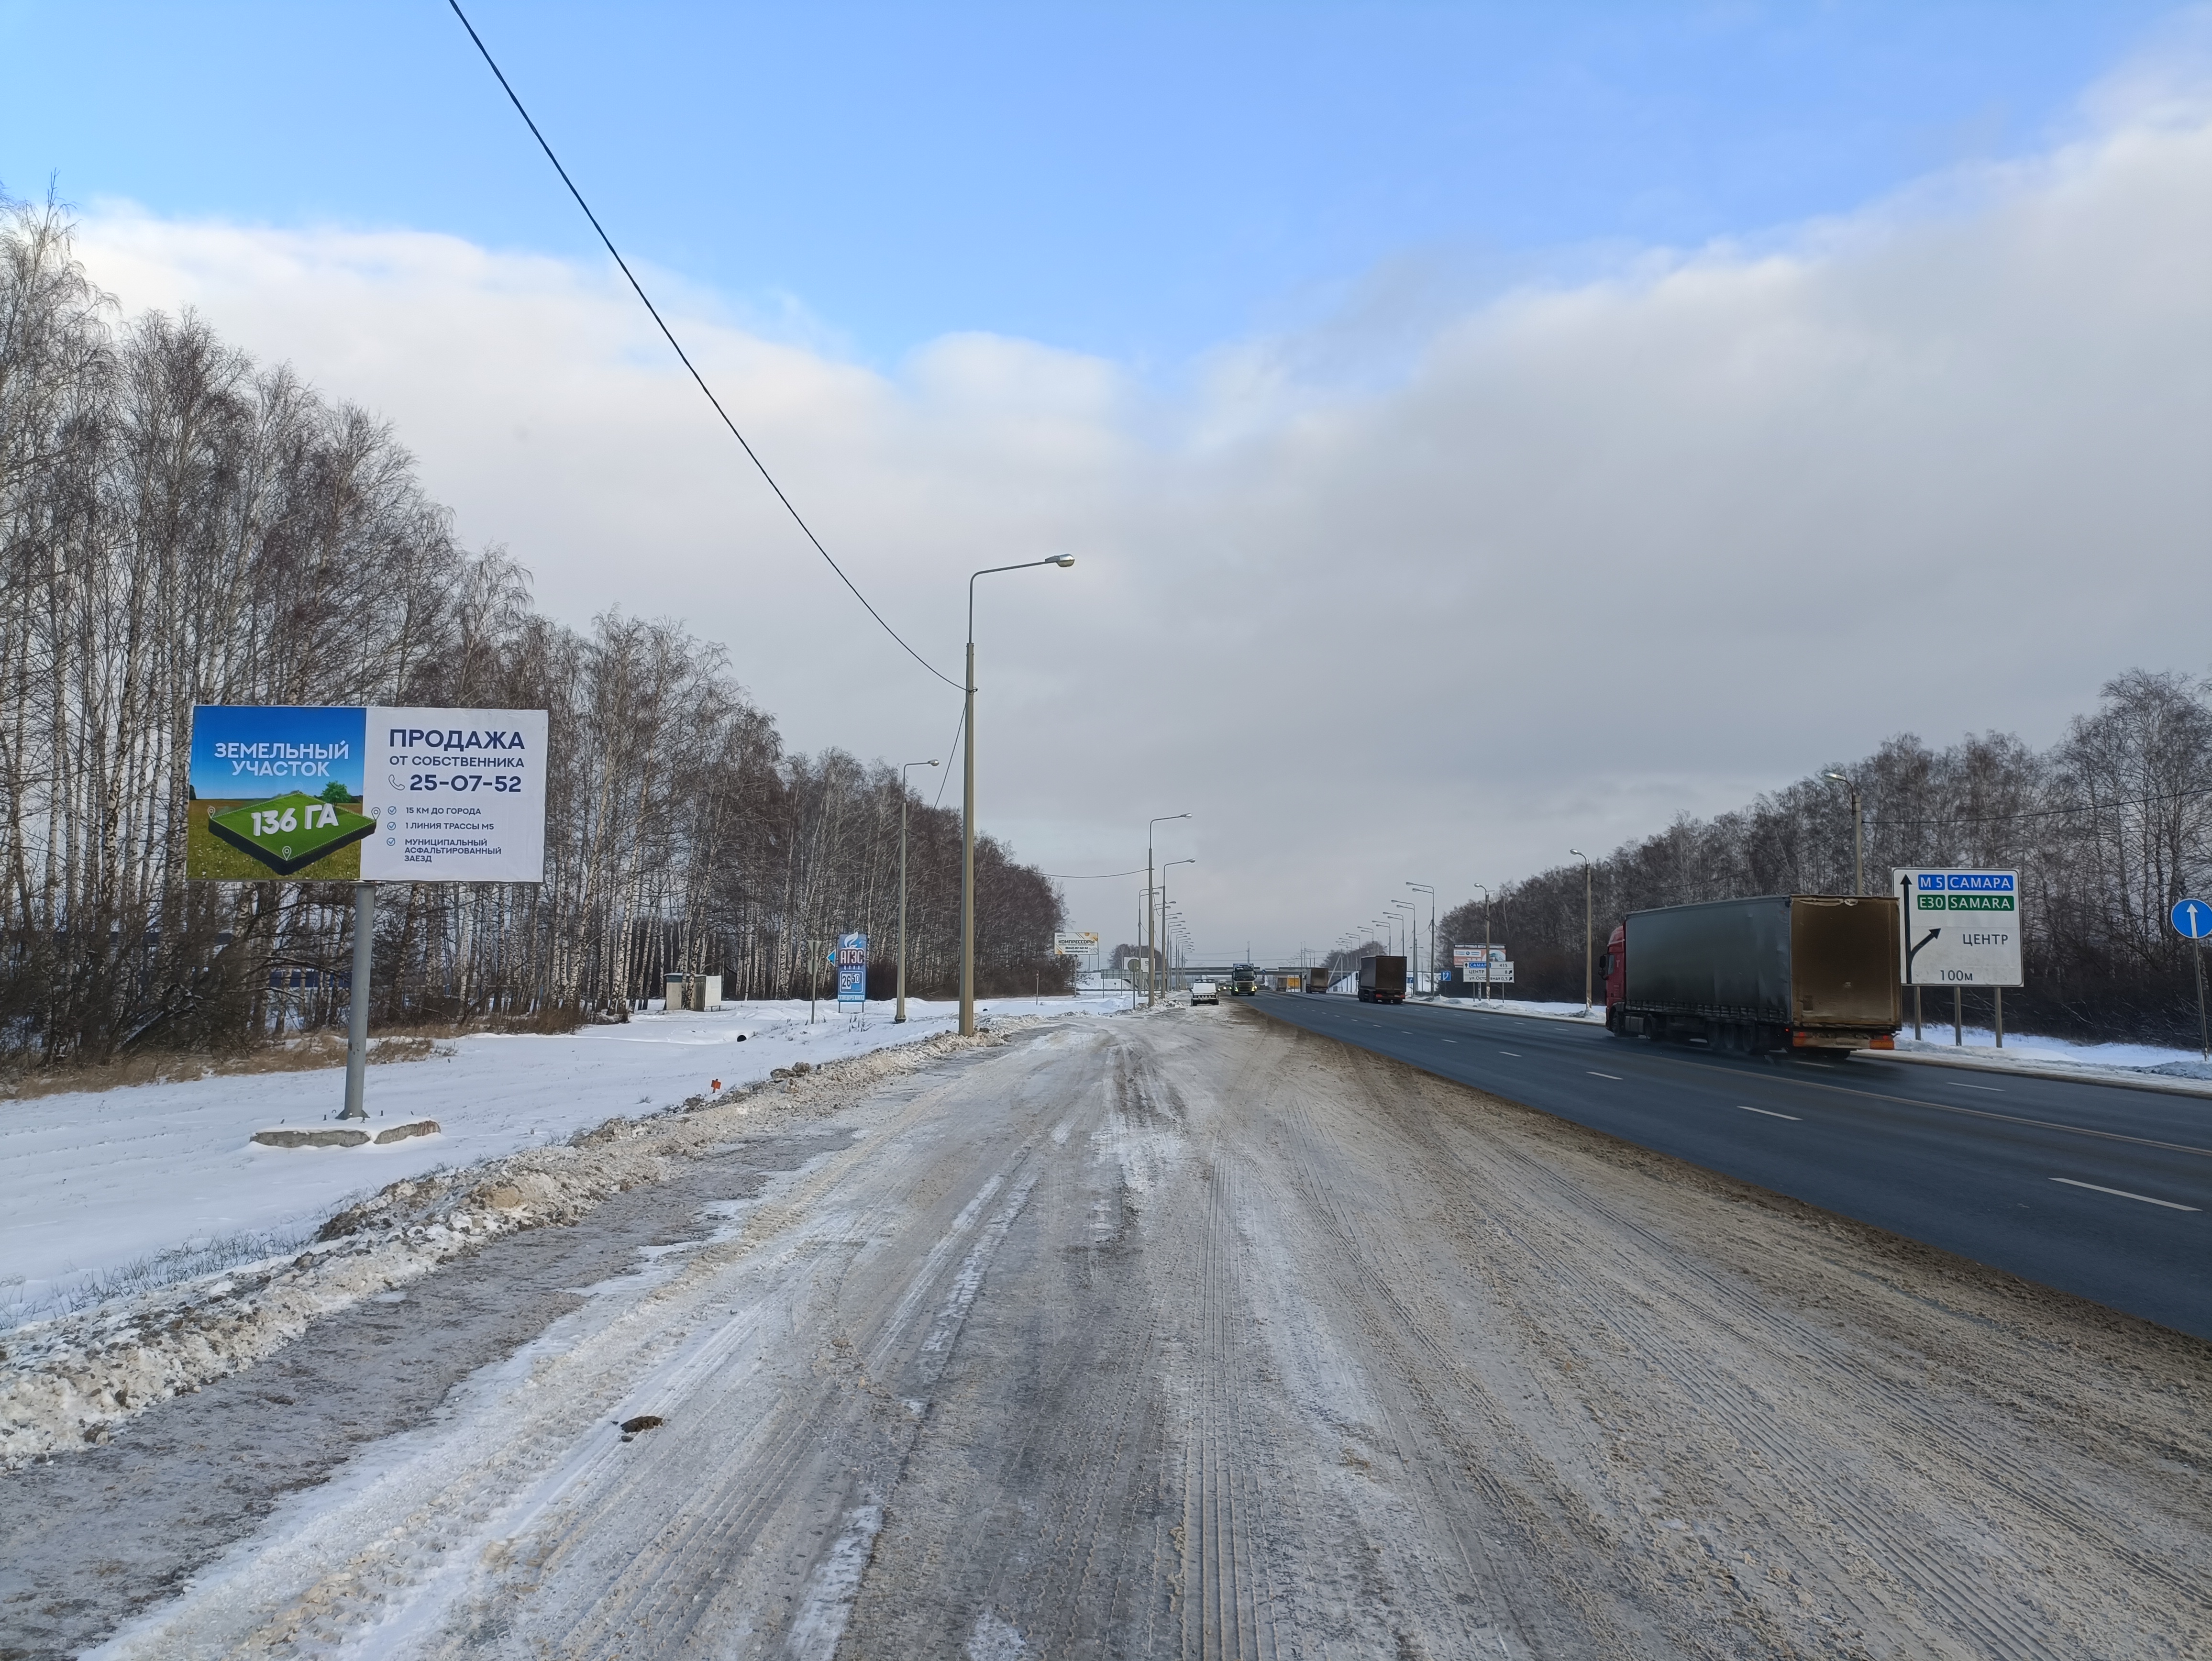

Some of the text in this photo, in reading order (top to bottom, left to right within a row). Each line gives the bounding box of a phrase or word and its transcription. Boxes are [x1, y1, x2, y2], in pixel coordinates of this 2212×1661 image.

[390, 729, 525, 752] ПРОДАЖА
[214, 740, 349, 759] ЗЕМЕЛЬНЫЙ
[389, 755, 525, 767] ОТ СОБСТВЕННИКА
[232, 761, 330, 776] УЧАСТОК
[410, 774, 521, 792] 25-07-52
[446, 808, 481, 816] ГОРОДА
[251, 803, 339, 836] 136 ГА
[405, 838, 487, 846] МУНИЦИПАЛЬНЫЙ
[404, 846, 501, 854] АСФАЛЬТИРОВАННЫЙ
[404, 855, 432, 863] ЗАЕЗД
[1950, 877, 2011, 888] САМАРА
[1920, 897, 2011, 909] E30 SAMARA
[1963, 934, 2008, 946] ЦЕНТР
[840, 950, 863, 964] АГЗС
[842, 974, 860, 987] 26 50
[1940, 970, 1973, 981] 100м
